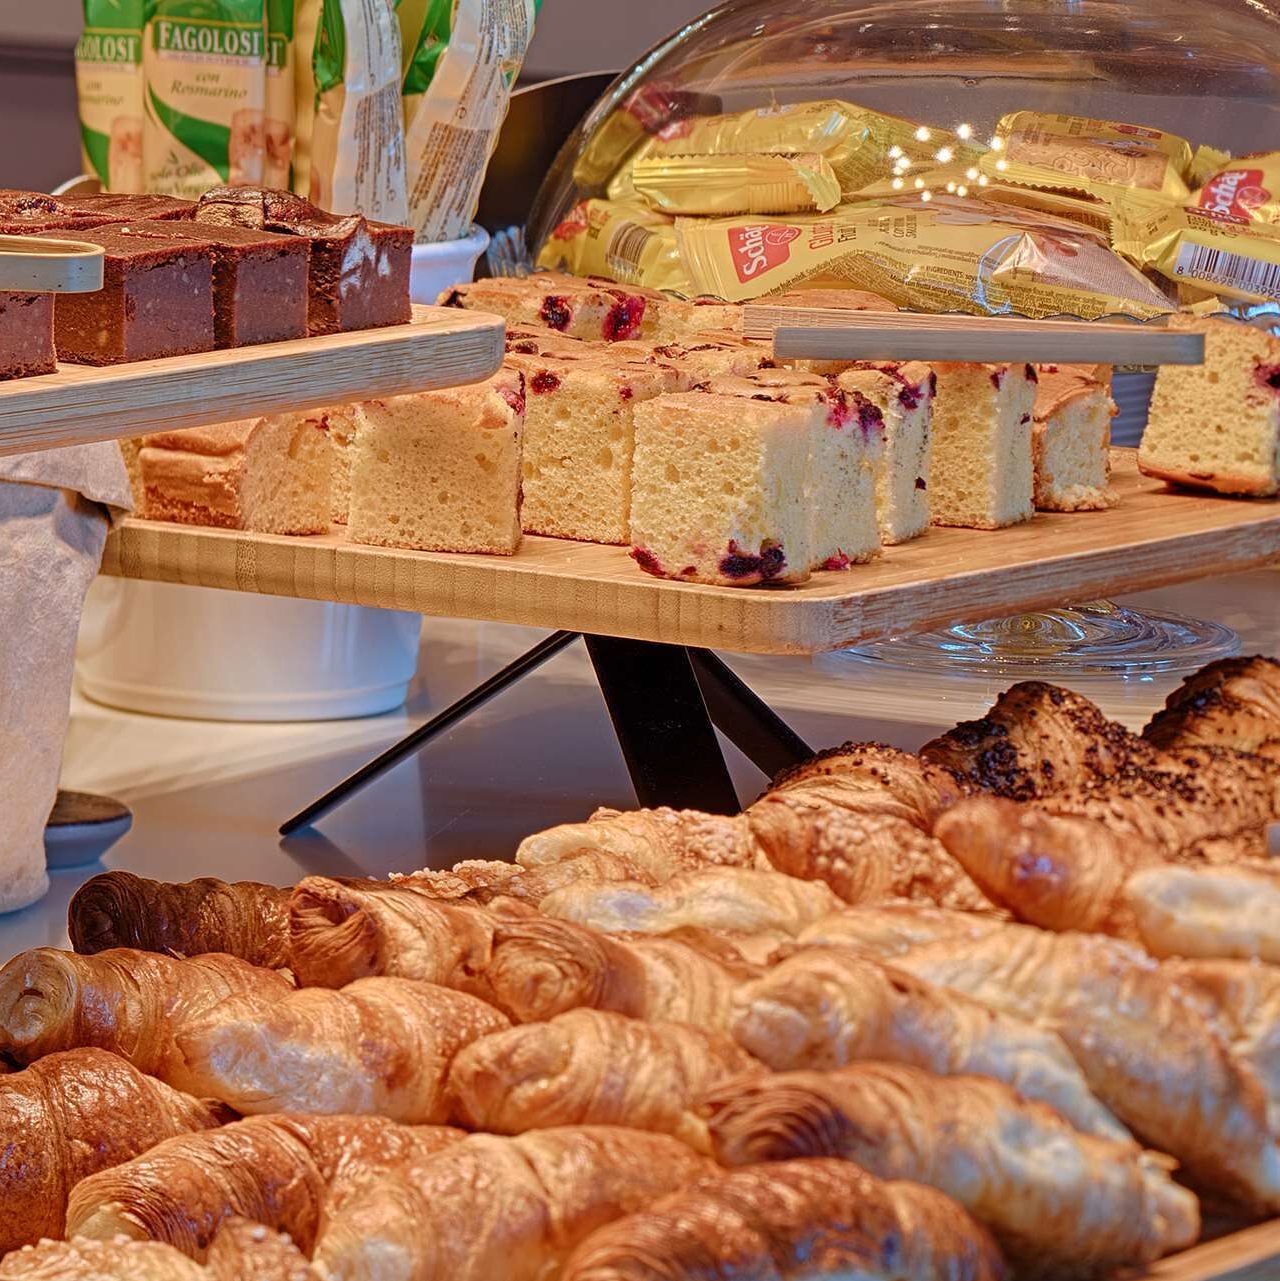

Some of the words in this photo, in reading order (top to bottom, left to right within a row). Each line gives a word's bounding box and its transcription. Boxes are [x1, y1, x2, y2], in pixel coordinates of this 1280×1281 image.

[159, 21, 262, 55] FAGOLOSI
[195, 72, 220, 82] con
[170, 80, 248, 99] Rosmarino
[1176, 266, 1184, 275] 8
[1191, 270, 1234, 288] 008698
